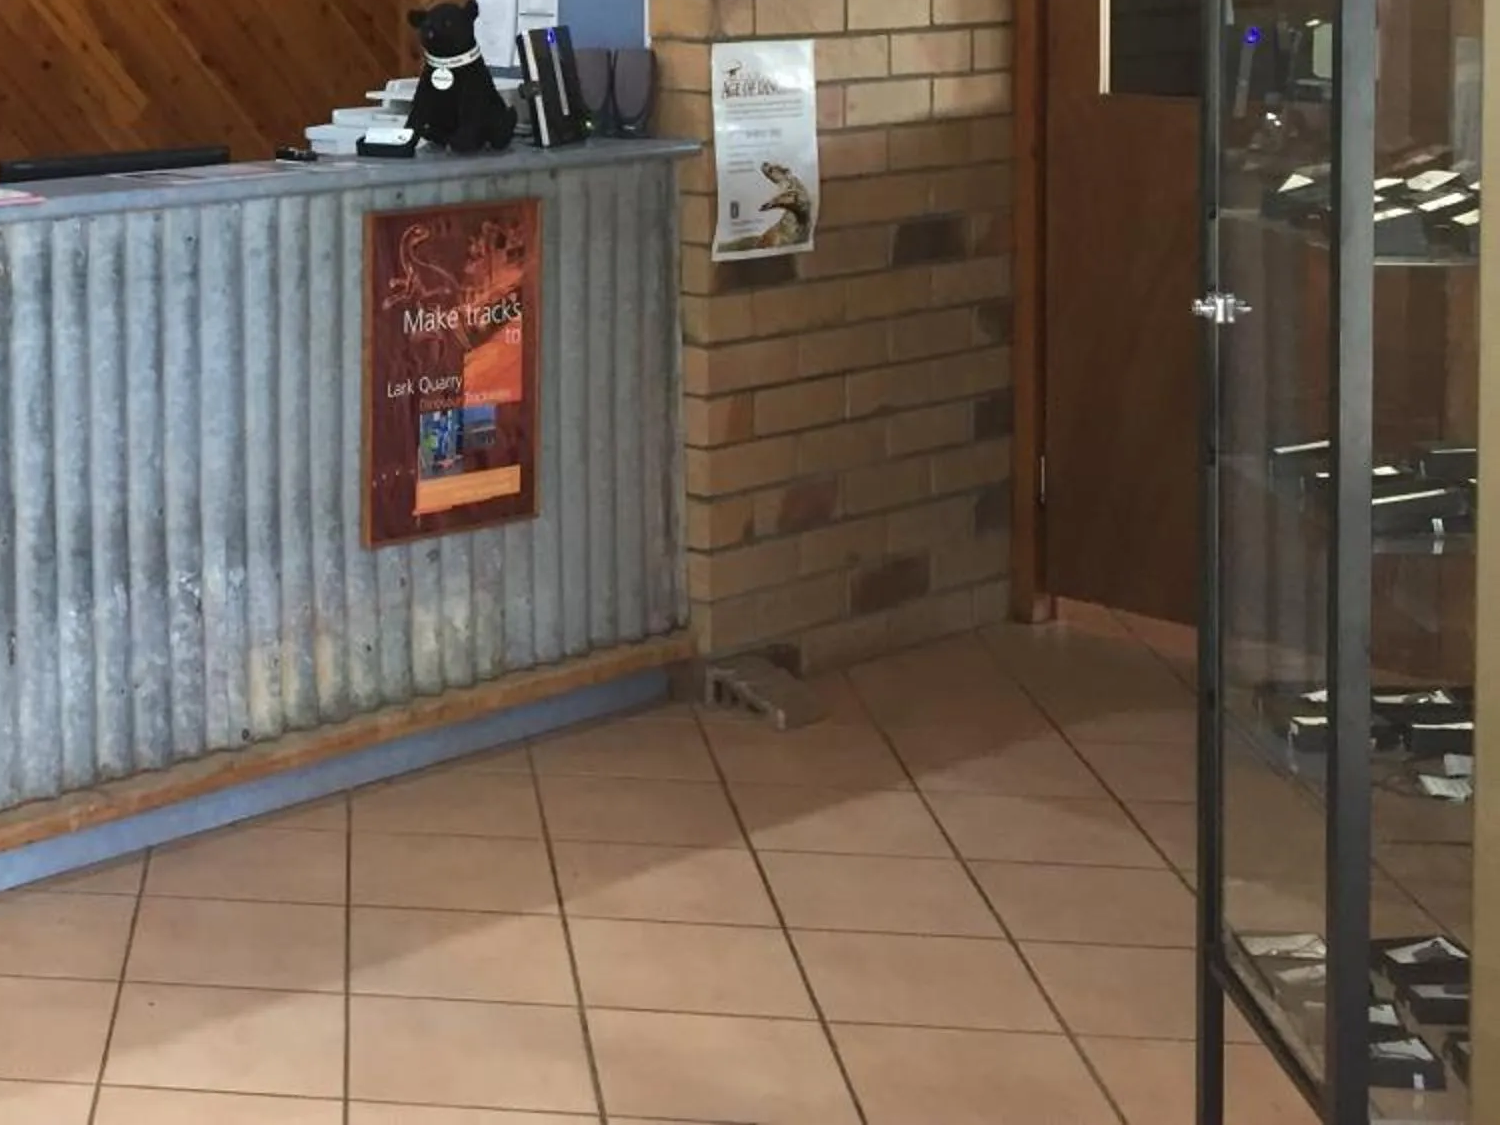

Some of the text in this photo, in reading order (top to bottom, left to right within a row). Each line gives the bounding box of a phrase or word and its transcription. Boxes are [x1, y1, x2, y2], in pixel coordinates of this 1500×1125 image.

[403, 298, 522, 335] Make tracks
[505, 327, 521, 344] to
[387, 375, 462, 398] Lark Quarry
